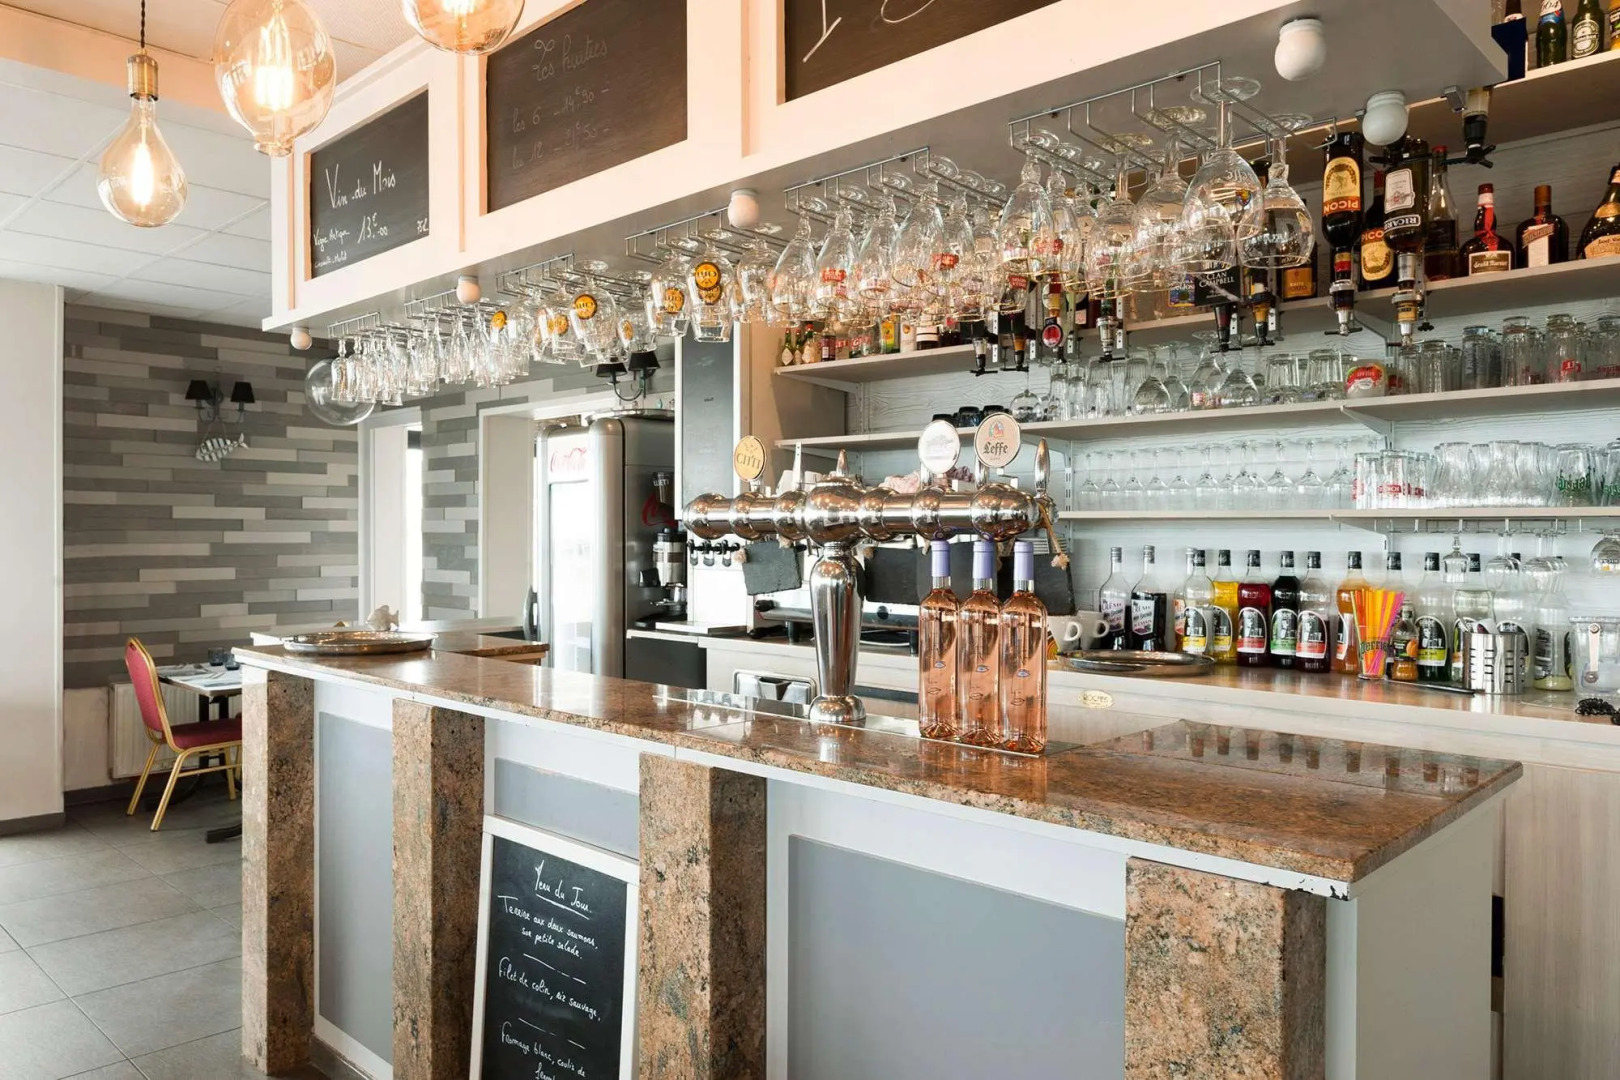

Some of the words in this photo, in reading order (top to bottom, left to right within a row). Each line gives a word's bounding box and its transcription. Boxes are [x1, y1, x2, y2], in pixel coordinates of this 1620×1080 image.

[325, 163, 348, 208] Vin
[373, 160, 396, 195] Mois
[1324, 200, 1359, 214] PICON
[1361, 230, 1385, 241] PICO
[983, 441, 1008, 456] Leffe
[555, 880, 565, 899] du
[498, 895, 530, 920] Terrine
[534, 917, 545, 926] aux
[547, 918, 563, 933] deux
[522, 927, 532, 937] sur
[534, 933, 554, 945] petite
[499, 957, 517, 981] Filet
[519, 972, 529, 988] de
[556, 991, 567, 1002] riz
[501, 1021, 530, 1055] Fromage
[557, 1059, 575, 1072] coulis
[577, 1067, 586, 1078] de
